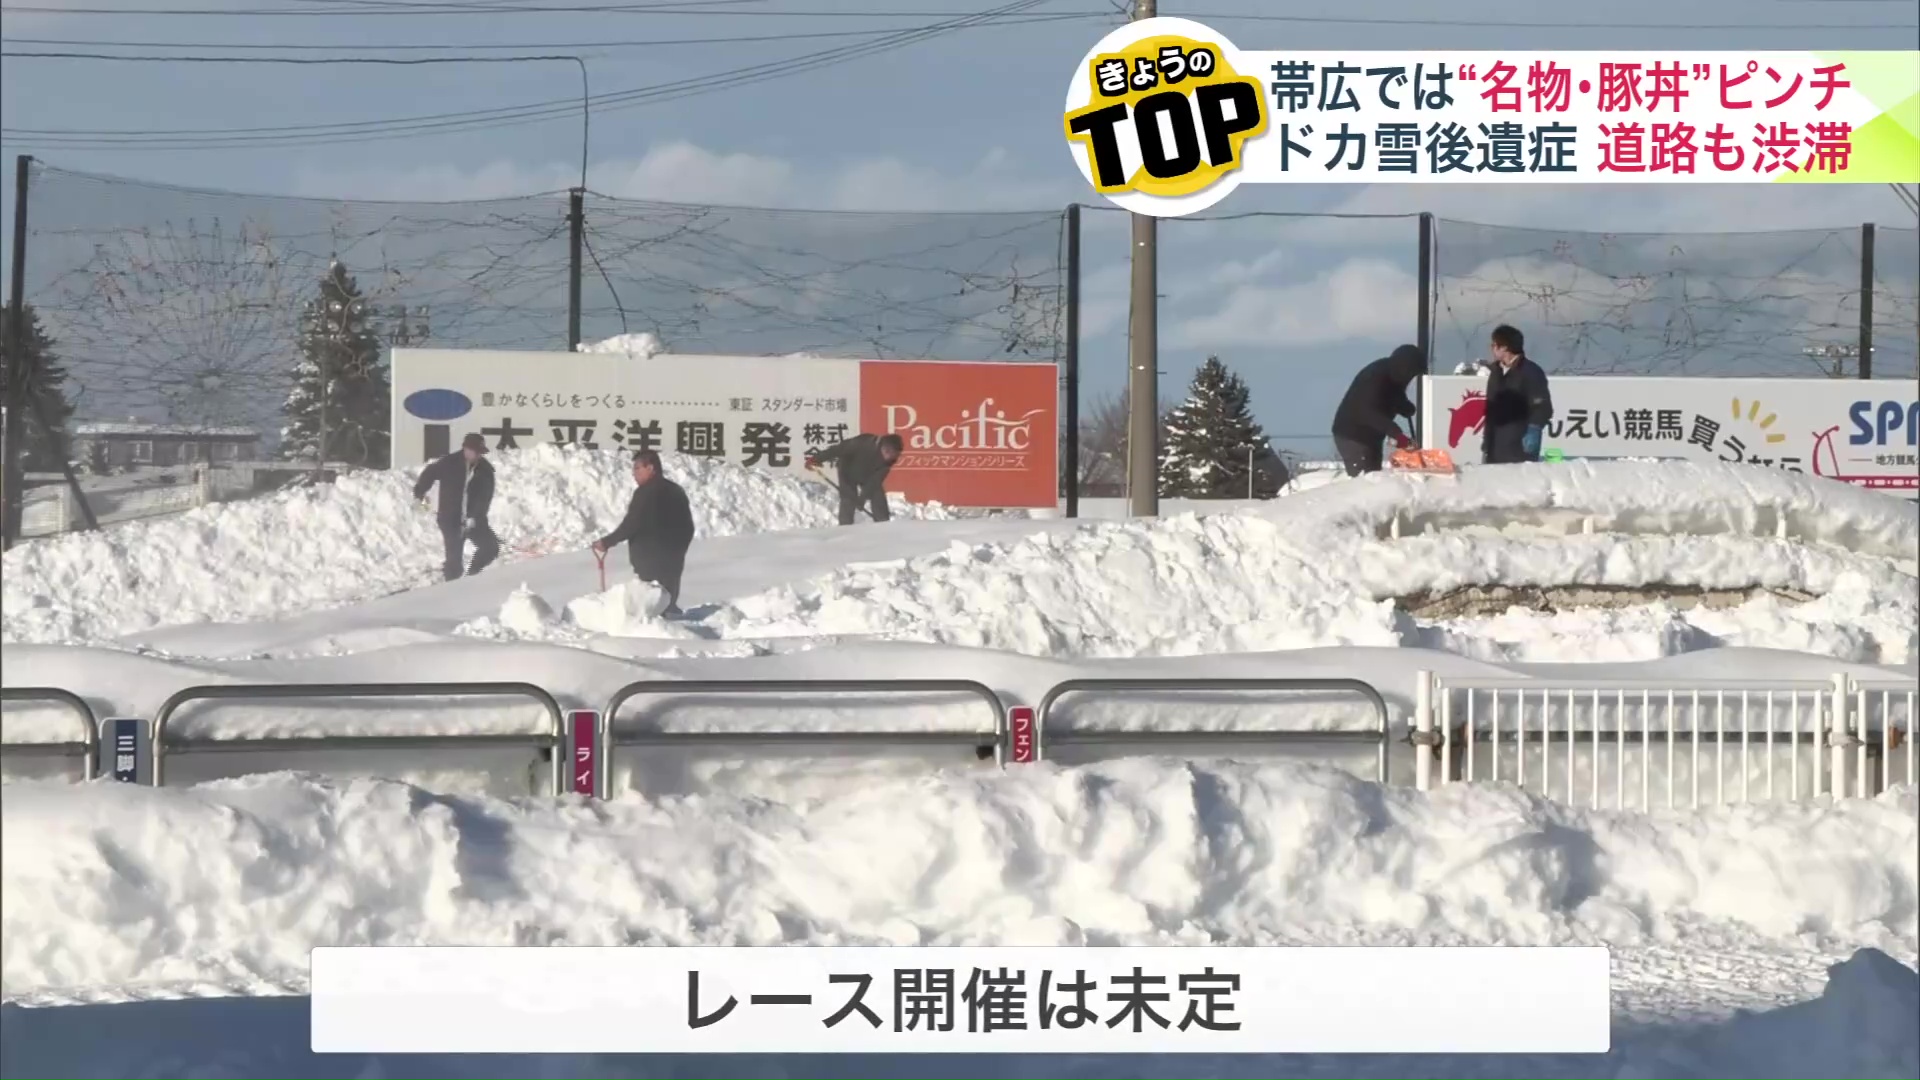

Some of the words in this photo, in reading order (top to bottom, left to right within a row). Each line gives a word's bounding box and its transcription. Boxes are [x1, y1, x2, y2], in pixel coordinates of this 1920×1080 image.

[881, 397, 1047, 450] Pacific
[1876, 454, 1919, 466] 地方競馬
[576, 747, 592, 797] ライ
